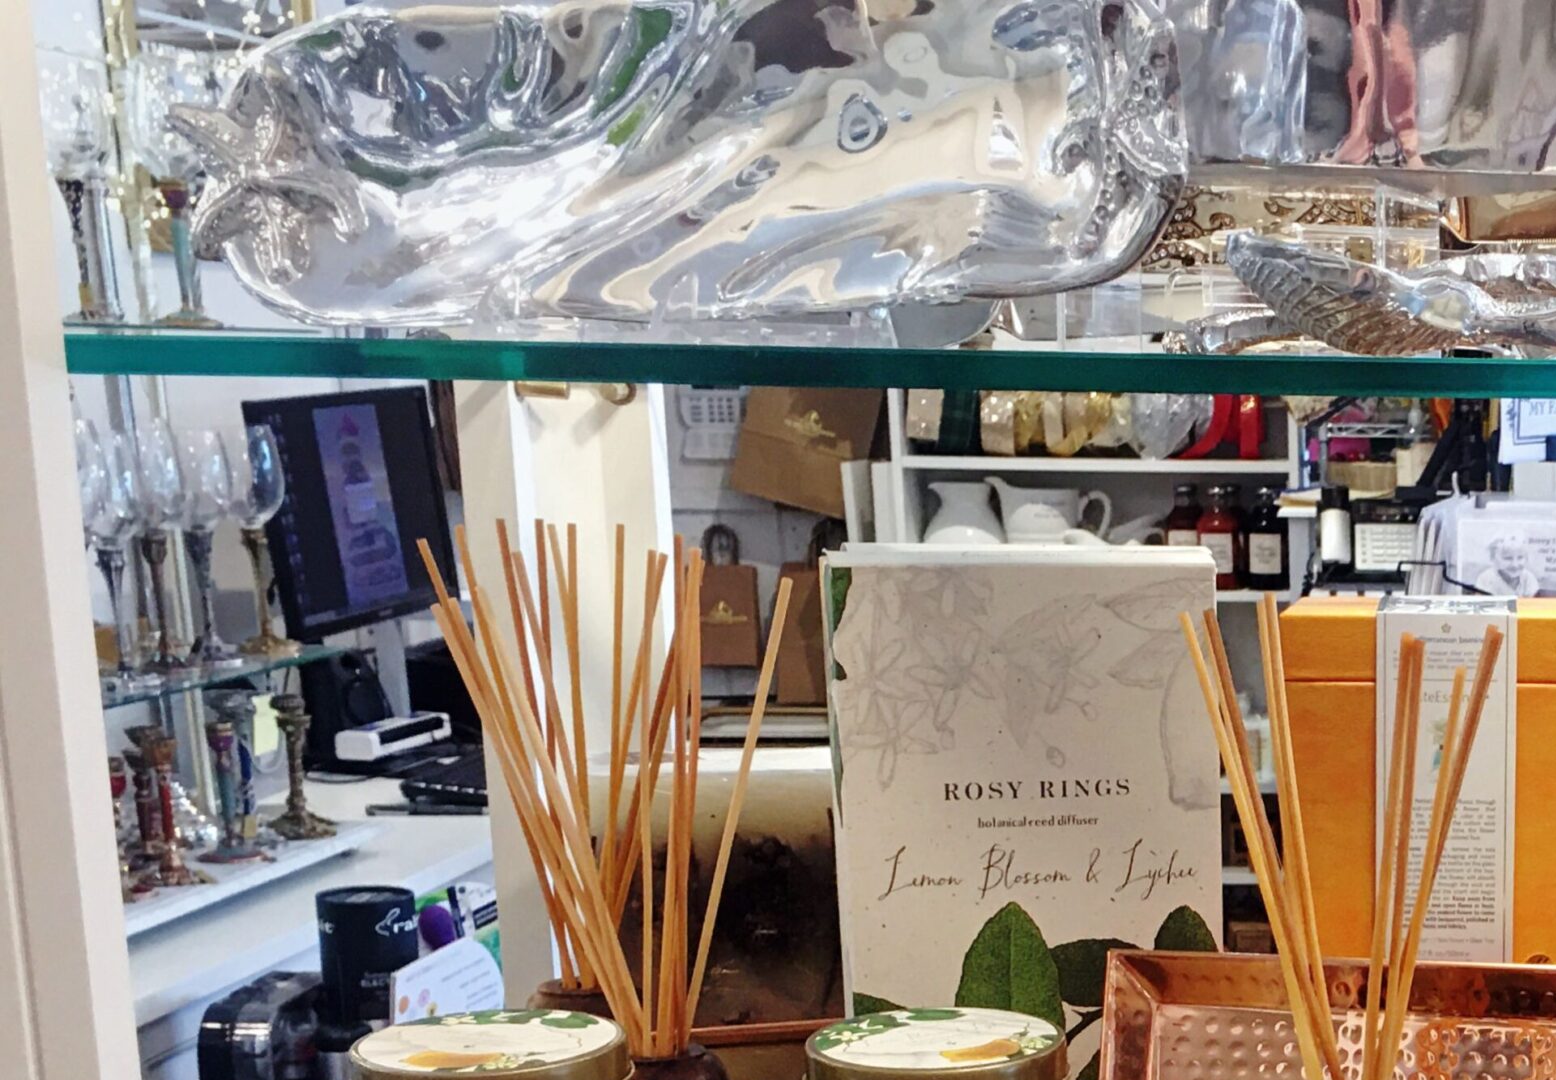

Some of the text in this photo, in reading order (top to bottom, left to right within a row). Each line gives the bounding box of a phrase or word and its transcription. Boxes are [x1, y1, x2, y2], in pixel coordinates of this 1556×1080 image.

[944, 779, 1131, 801] ROSY RINGS
[978, 815, 1099, 829] botanical reed diffuser
[878, 838, 1197, 901] Lemon Blossom & Lychee
